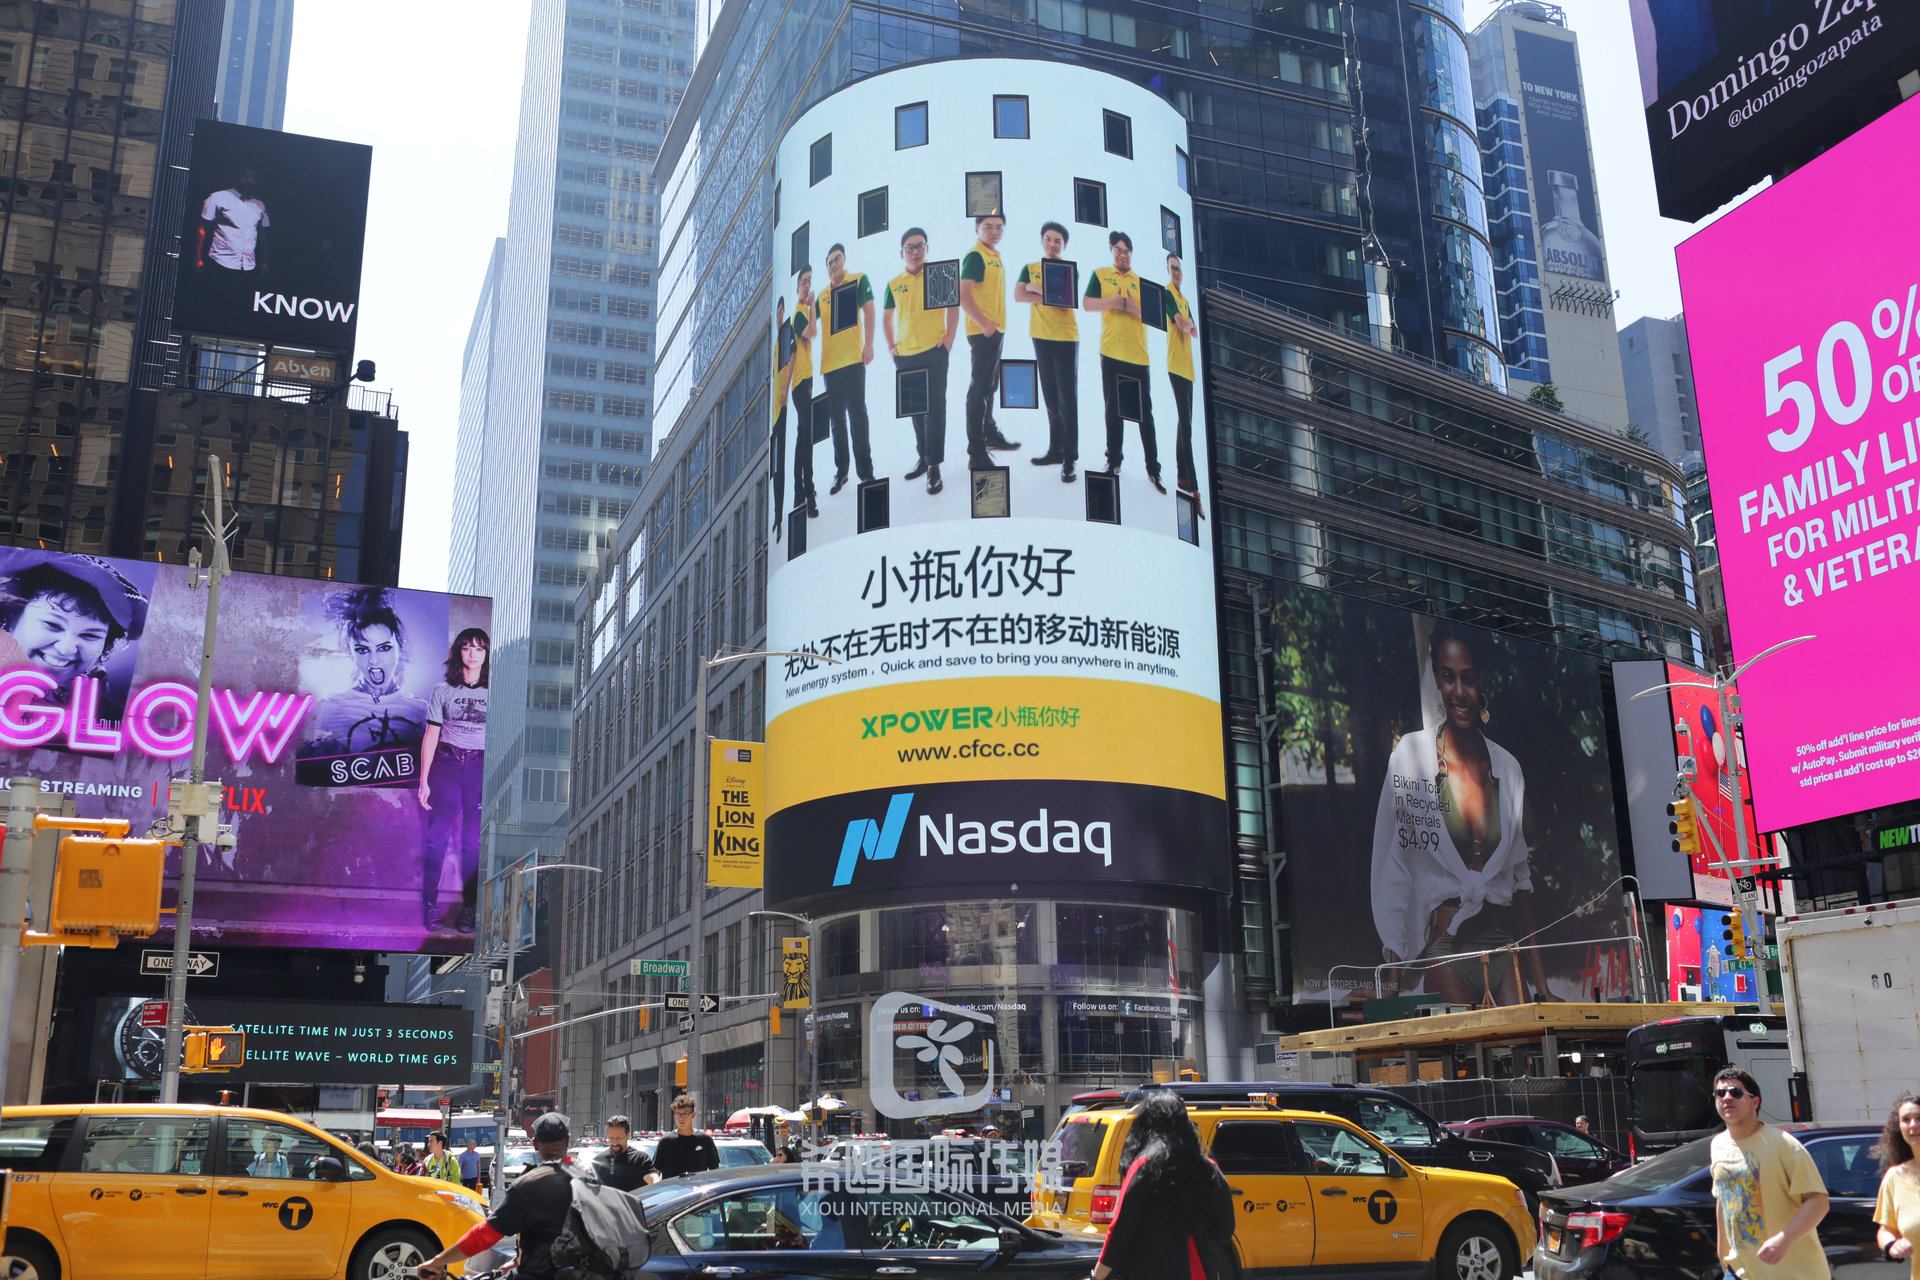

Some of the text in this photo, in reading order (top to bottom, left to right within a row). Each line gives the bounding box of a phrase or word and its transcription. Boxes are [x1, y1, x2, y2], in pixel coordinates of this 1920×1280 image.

[1667, 23, 1809, 140] Domingo
[1728, 15, 1883, 128] @domingozapata
[1522, 81, 1533, 92] TO
[1534, 84, 1553, 96] NEW
[253, 291, 355, 323] KNOW
[1738, 440, 1869, 535] FAMILY
[1767, 477, 1920, 568] FOR MILIT
[861, 544, 1075, 609] 小瓶你好
[1784, 574, 1804, 606] &
[784, 613, 1181, 682] 无处不在无时不在的移动新能源
[785, 683, 800, 699] New
[802, 676, 829, 693] energy
[880, 659, 915, 674] Quick
[918, 656, 943, 669] and
[945, 654, 977, 666] save
[980, 653, 993, 665] to
[997, 652, 1030, 666] bring
[1034, 654, 1058, 666] you
[1061, 655, 1121, 669] anywhere
[1125, 658, 1134, 670] in
[1136, 661, 1179, 678] anytime.
[0, 670, 313, 764] GLOW
[861, 706, 993, 739] XPOWER
[995, 706, 1081, 728] 小瓶你好
[897, 739, 1040, 763] www.cfcc.cc
[1796, 743, 1815, 757] 50%
[1816, 739, 1827, 751] off
[1849, 732, 1864, 743] line
[1865, 726, 1887, 740] price
[1888, 722, 1900, 732] for
[331, 753, 414, 783] SCAB
[1791, 762, 1801, 774] w/
[1838, 746, 1868, 761] Submit
[1868, 739, 1900, 755] military
[725, 776, 746, 784] Disney
[1800, 776, 1812, 788] std
[1813, 772, 1834, 786] price
[1834, 769, 1843, 780] at
[1865, 758, 1884, 771] cost
[1884, 757, 1896, 767] up
[1896, 754, 1906, 763] to
[40, 780, 143, 798] STREAMING
[721, 790, 749, 803] THE
[1393, 774, 1441, 797] Bikini Top
[1394, 792, 1451, 813] in Recycled
[717, 805, 754, 828] LION
[1396, 809, 1441, 829] Materials
[714, 829, 759, 857] KING
[918, 808, 1112, 867] Nasdaq
[1398, 826, 1440, 852] $4.99
[153, 957, 174, 968] ONE
[643, 962, 686, 977] Broadway
[1579, 944, 1627, 1001] H&M
[1303, 979, 1321, 988] NOW
[1323, 979, 1330, 988] IN
[1331, 980, 1357, 989] STORES
[1360, 981, 1374, 989] AND
[1072, 1002, 1098, 1010] Follow
[230, 1024, 454, 1040] SATELLITE TIME IN JUST 3 SECONDS
[1749, 1024, 1764, 1033] GO
[246, 1050, 458, 1065] ELLITE WAVE WORLD TIME GPS
[1655, 1044, 1665, 1053] GO
